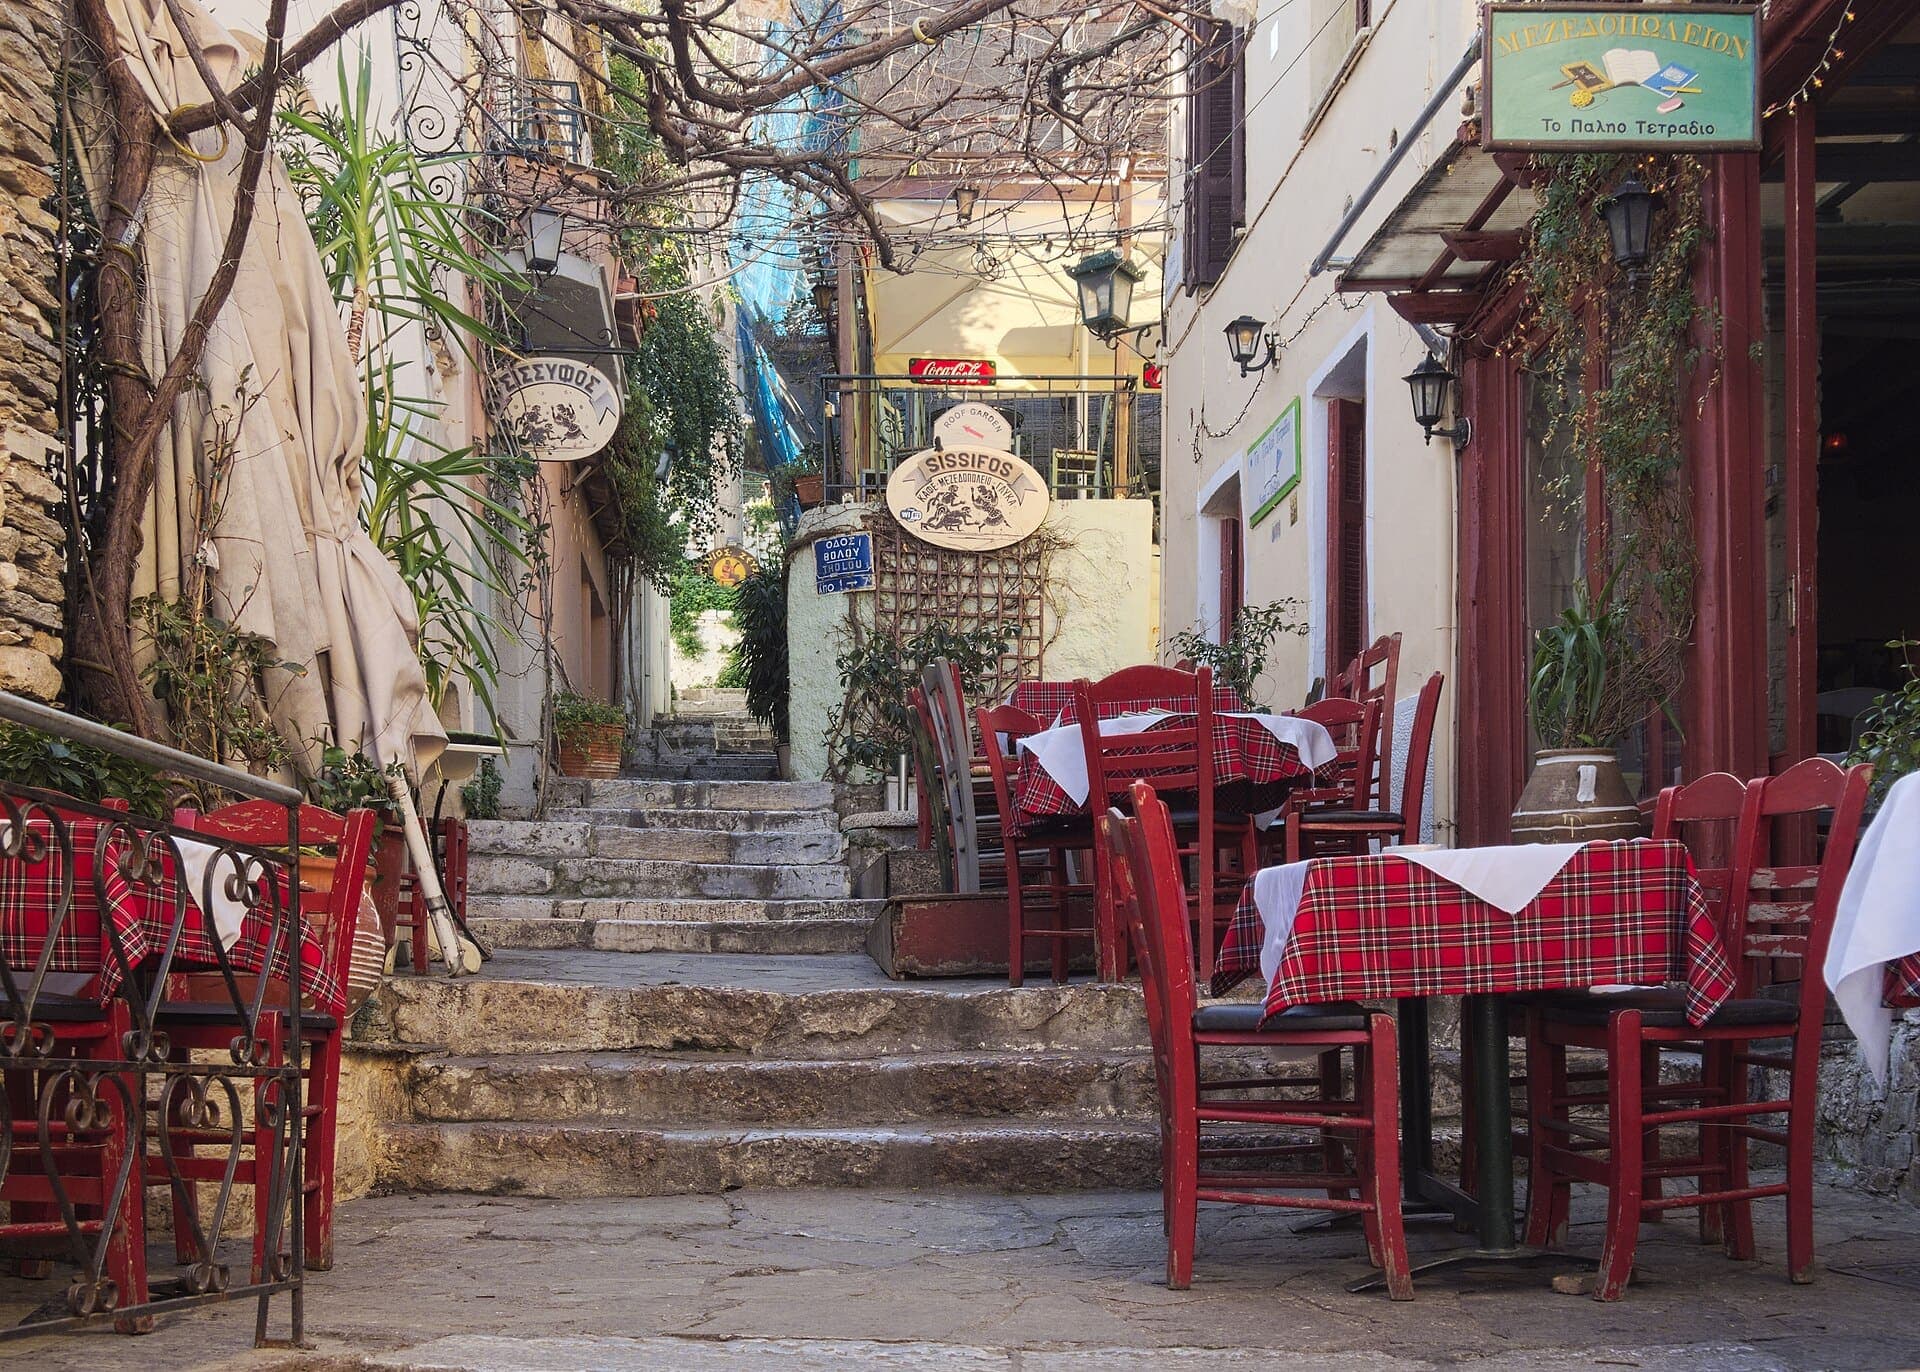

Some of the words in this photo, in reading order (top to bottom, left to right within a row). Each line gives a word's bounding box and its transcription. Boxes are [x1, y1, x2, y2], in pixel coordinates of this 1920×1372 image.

[1497, 13, 1751, 60] ΜΕΖΕΔΟΠΩΛΕΙΟΝ
[1542, 118, 1561, 133] Το
[1636, 120, 1715, 137] Τετραδιο
[943, 408, 966, 429] ROOF
[970, 407, 1003, 433] GARDEN
[925, 452, 1013, 478] SISSIFOS
[826, 537, 855, 549] ΟΔΟΣ
[824, 548, 859, 561] ΘΟΛΟΥ
[823, 560, 861, 574] THOLOU
